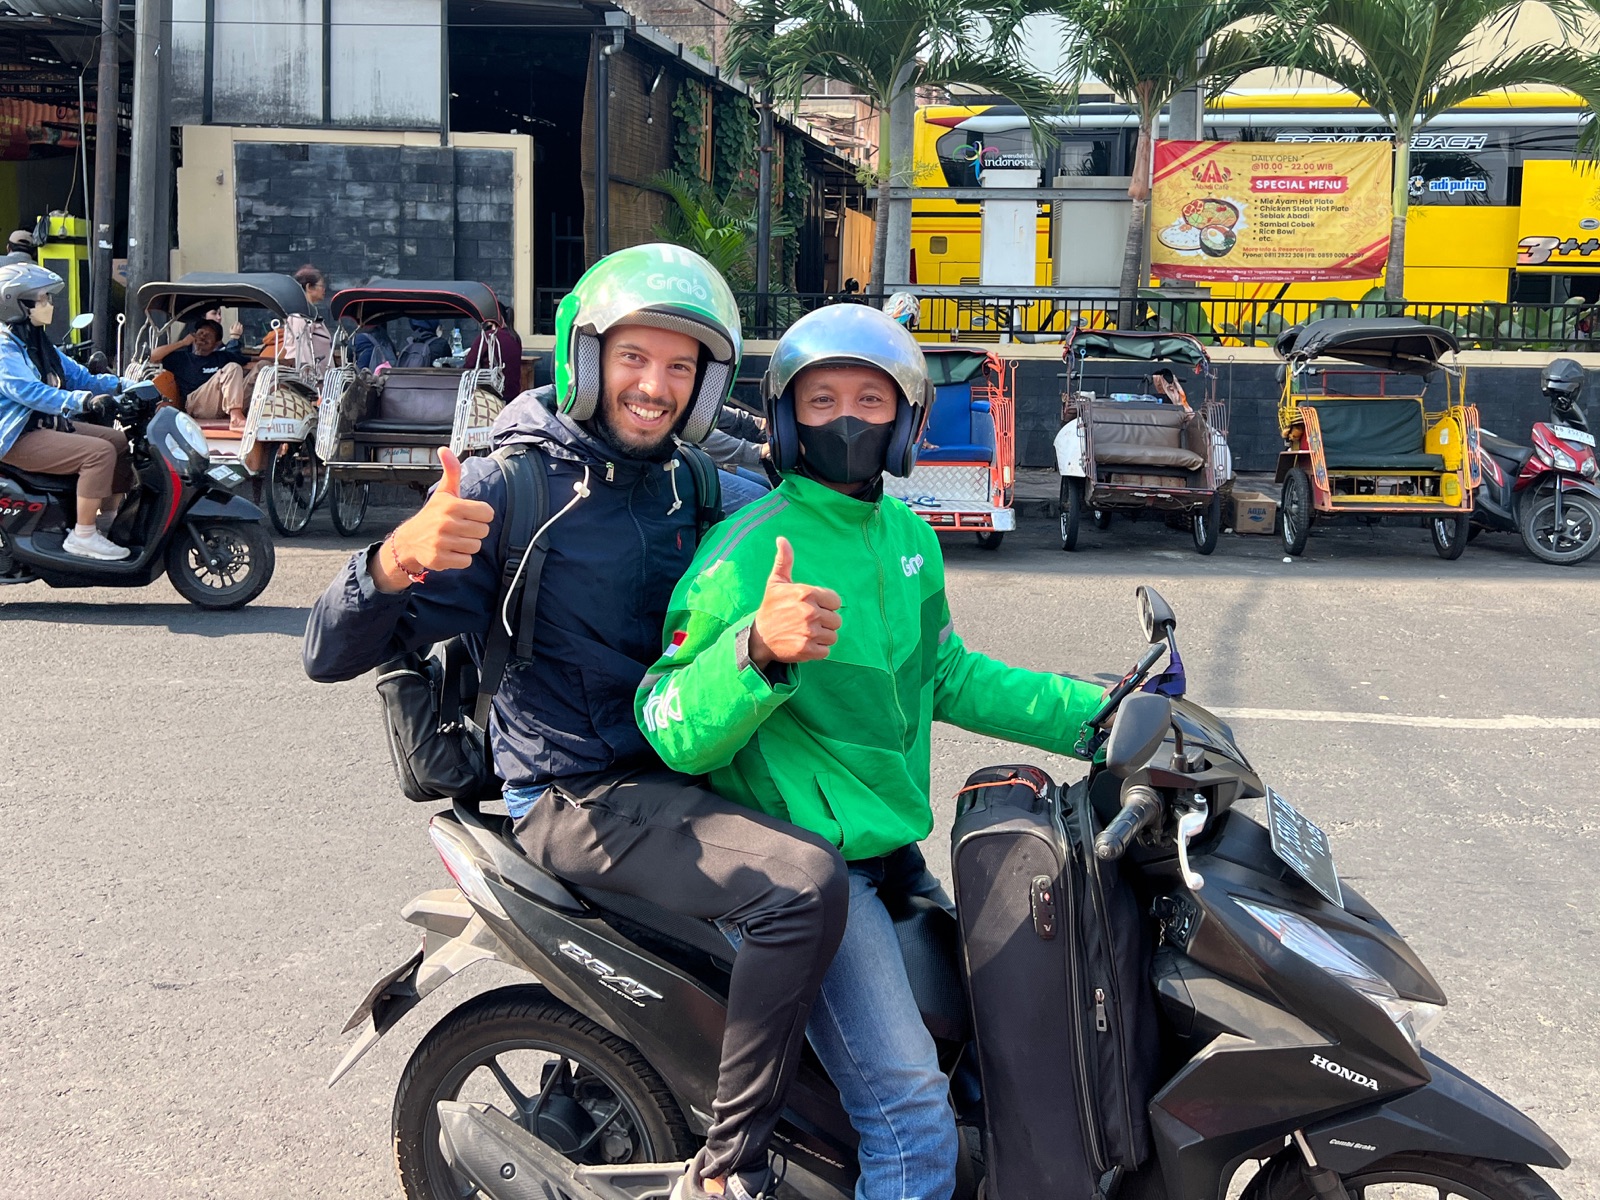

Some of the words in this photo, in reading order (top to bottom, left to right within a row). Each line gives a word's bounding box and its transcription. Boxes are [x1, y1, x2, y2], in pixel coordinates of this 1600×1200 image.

[984, 157, 1034, 167] indonesia
[1251, 163, 1283, 171] @10.00
[1255, 180, 1305, 190] SPECIAL
[1309, 180, 1342, 190] MENU
[1275, 198, 1298, 207] Ayam
[646, 273, 707, 301] Grab
[1309, 1053, 1379, 1092] HONDA
[1329, 1138, 1356, 1149] Combi
